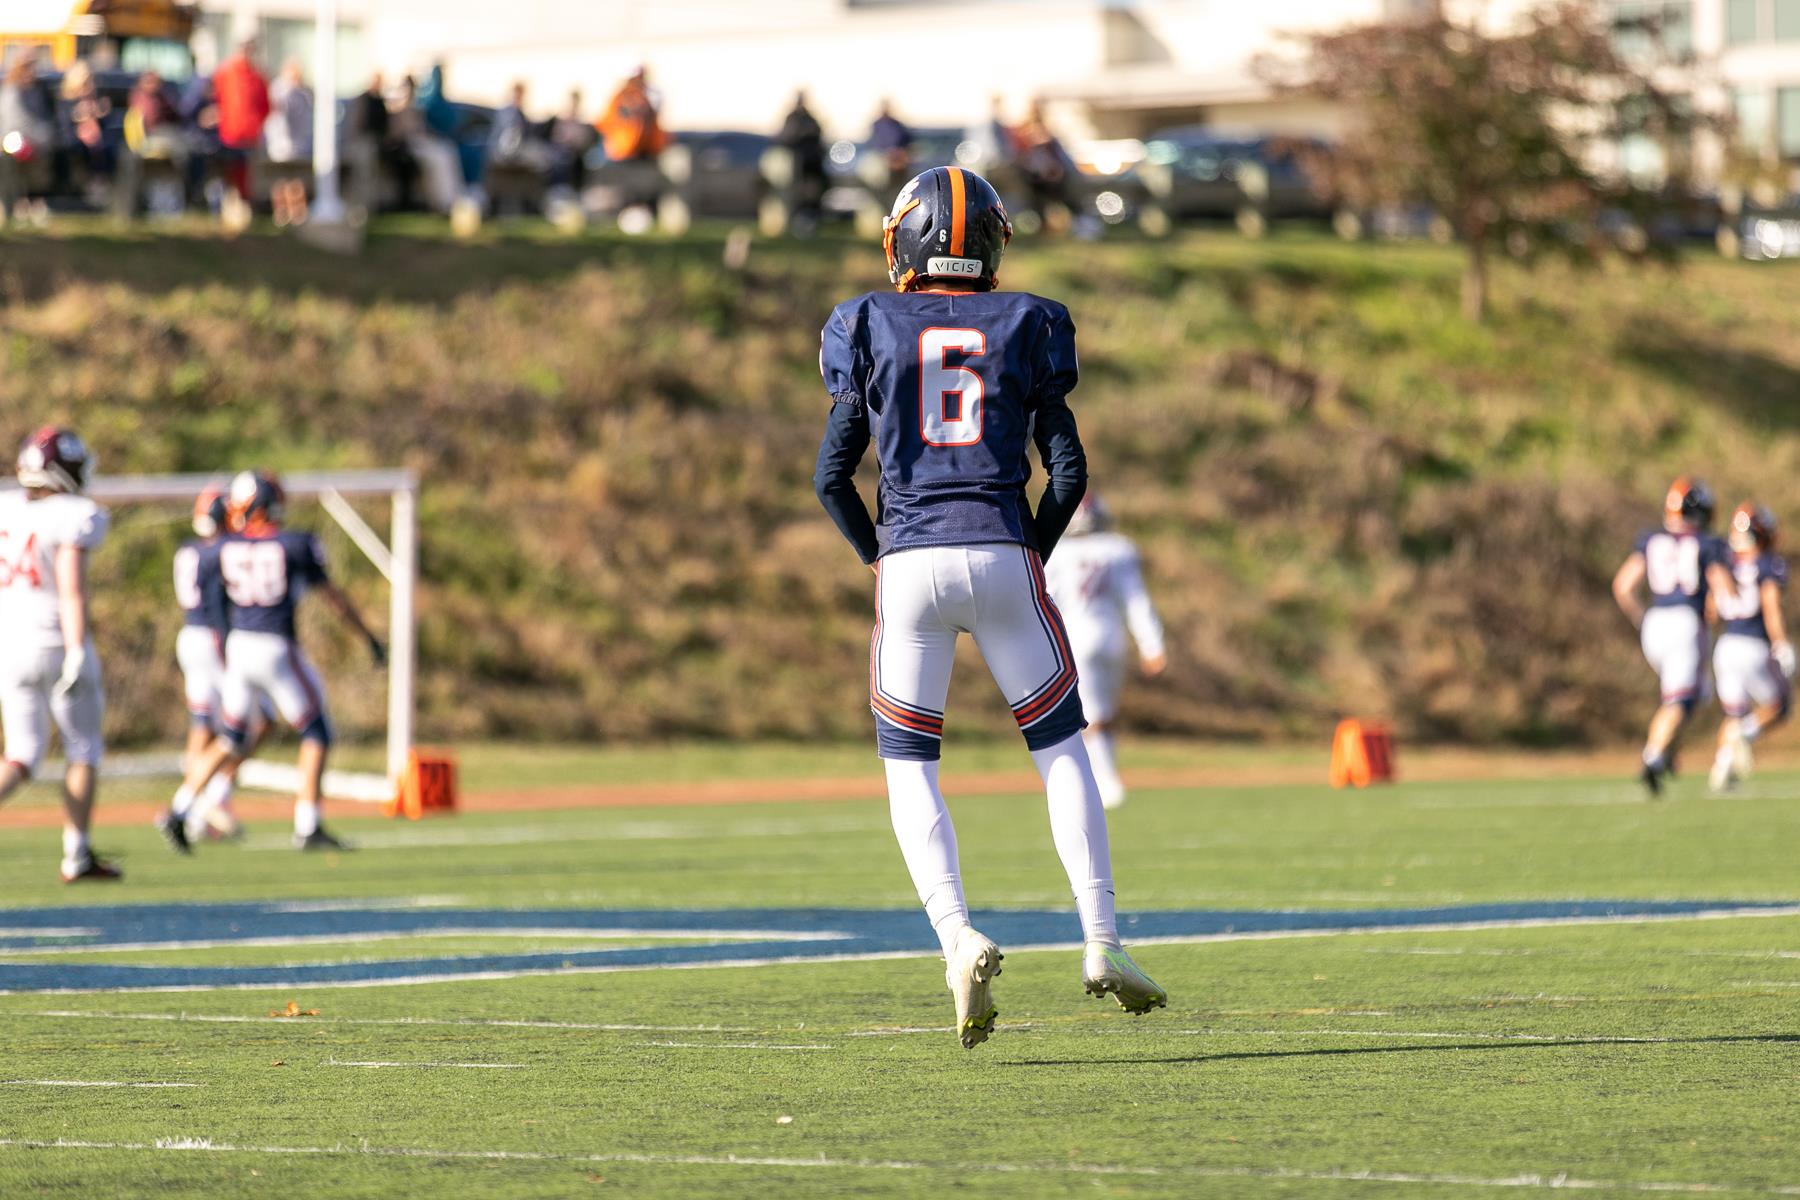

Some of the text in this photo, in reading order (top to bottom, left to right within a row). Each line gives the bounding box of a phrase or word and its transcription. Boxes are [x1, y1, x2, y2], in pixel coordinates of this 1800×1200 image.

[939, 229, 948, 243] 6
[935, 262, 975, 273] VICIS
[918, 326, 986, 447] 6
